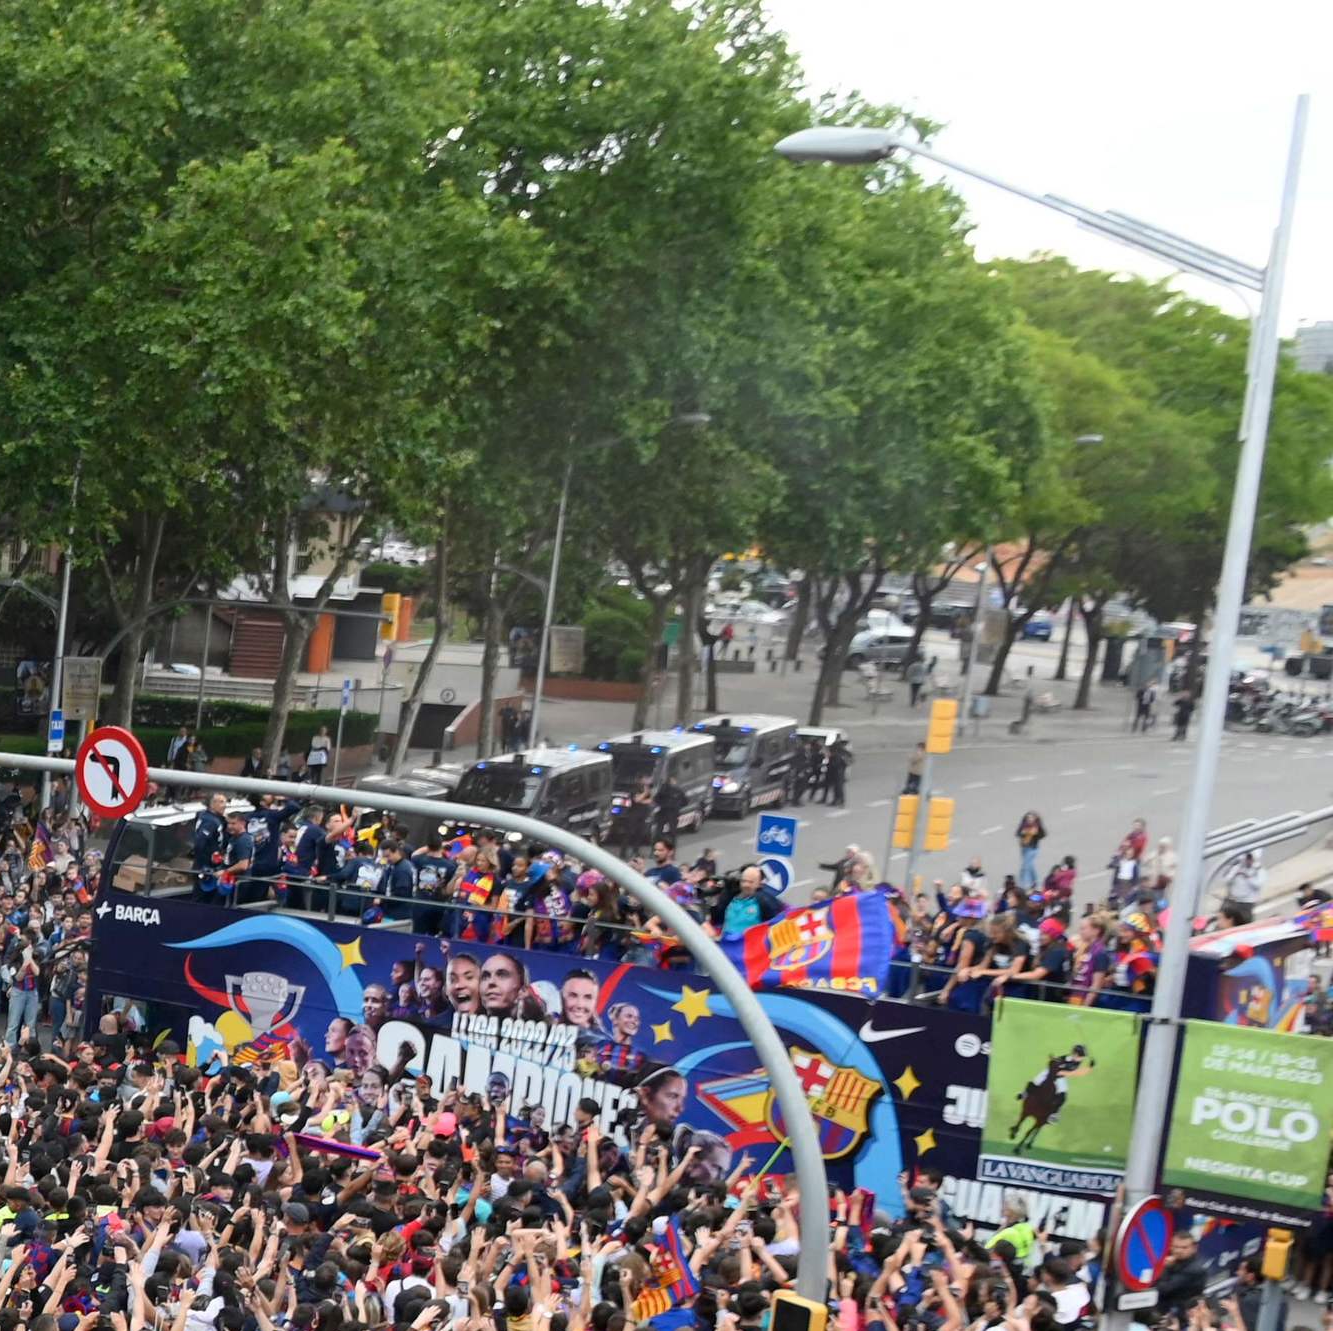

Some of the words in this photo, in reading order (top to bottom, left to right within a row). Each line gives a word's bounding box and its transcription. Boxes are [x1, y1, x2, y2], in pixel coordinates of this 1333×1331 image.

[115, 904, 160, 926] BARÇA
[498, 1018, 579, 1073] 2022/23
[1190, 1096, 1320, 1143] POLO
[1268, 1170, 1310, 1187] CUP
